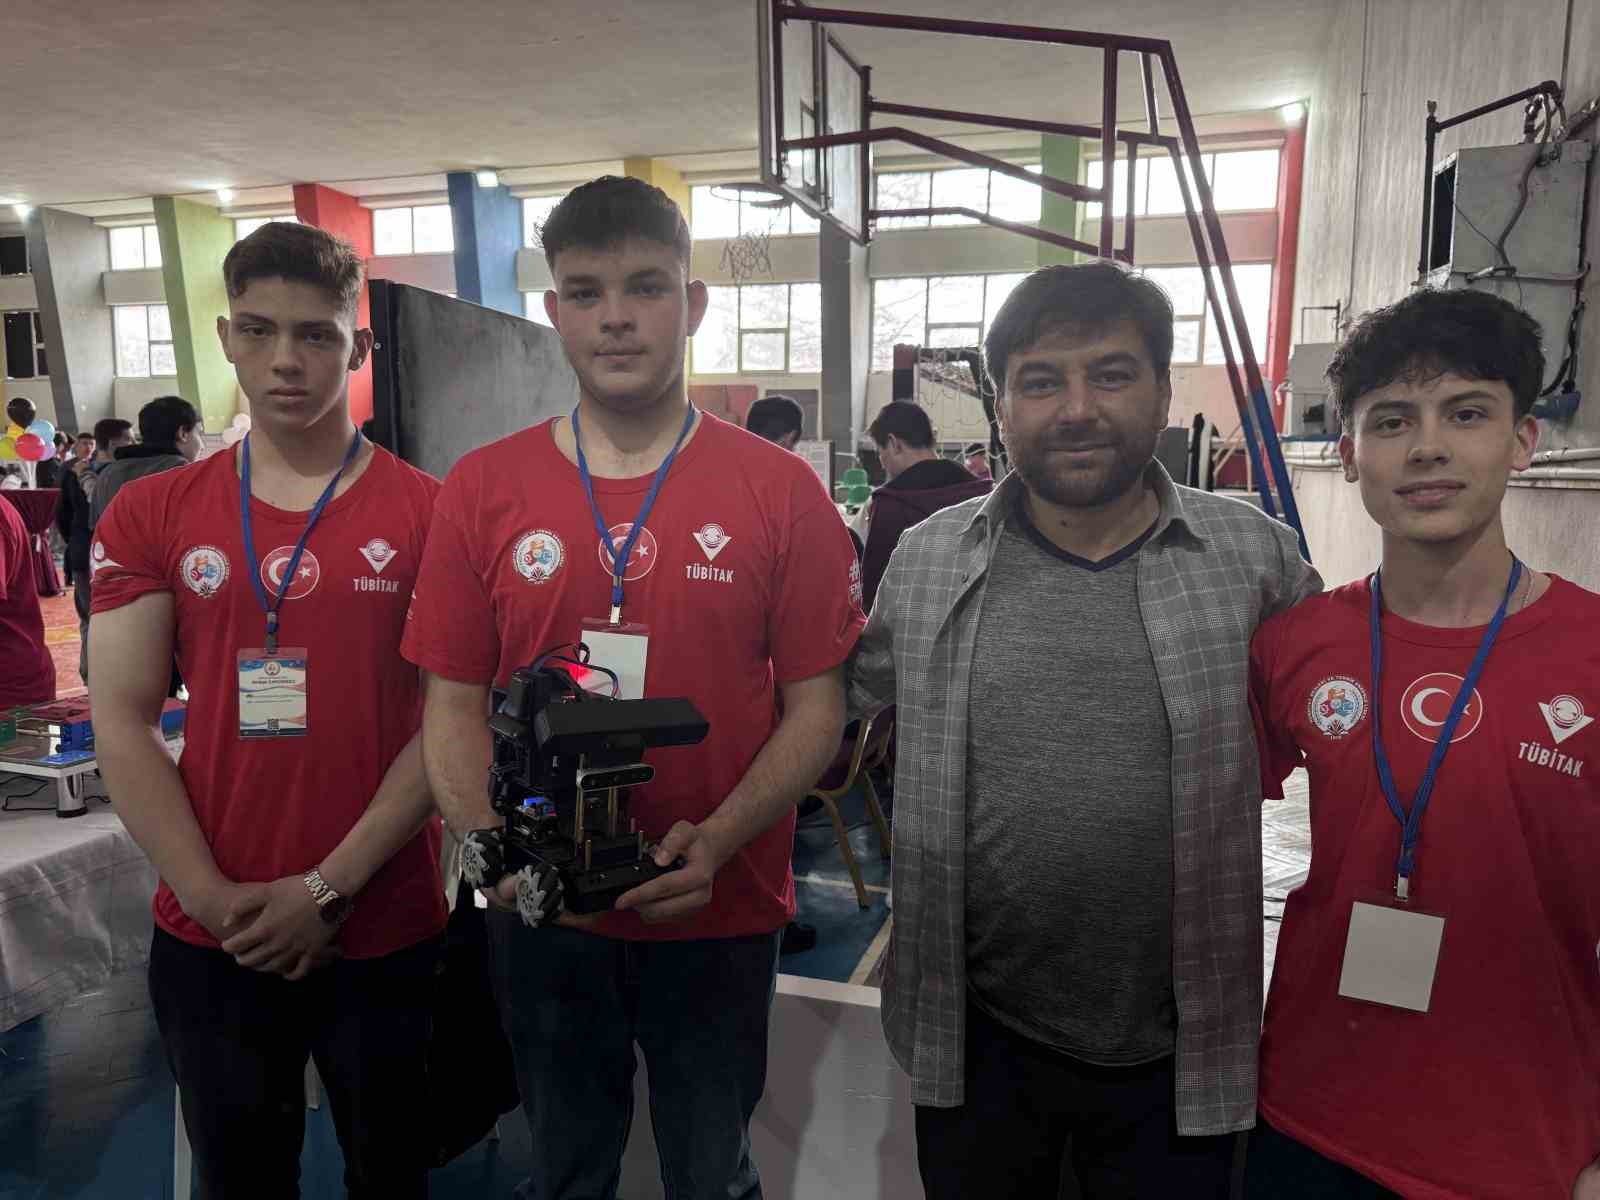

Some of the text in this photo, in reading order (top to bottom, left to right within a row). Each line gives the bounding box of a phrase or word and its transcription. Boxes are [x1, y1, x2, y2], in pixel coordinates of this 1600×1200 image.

[685, 563, 734, 583] TÜBİTAK
[352, 576, 400, 592] TÜBİTAK
[1518, 741, 1584, 777] TÜBİTAK
